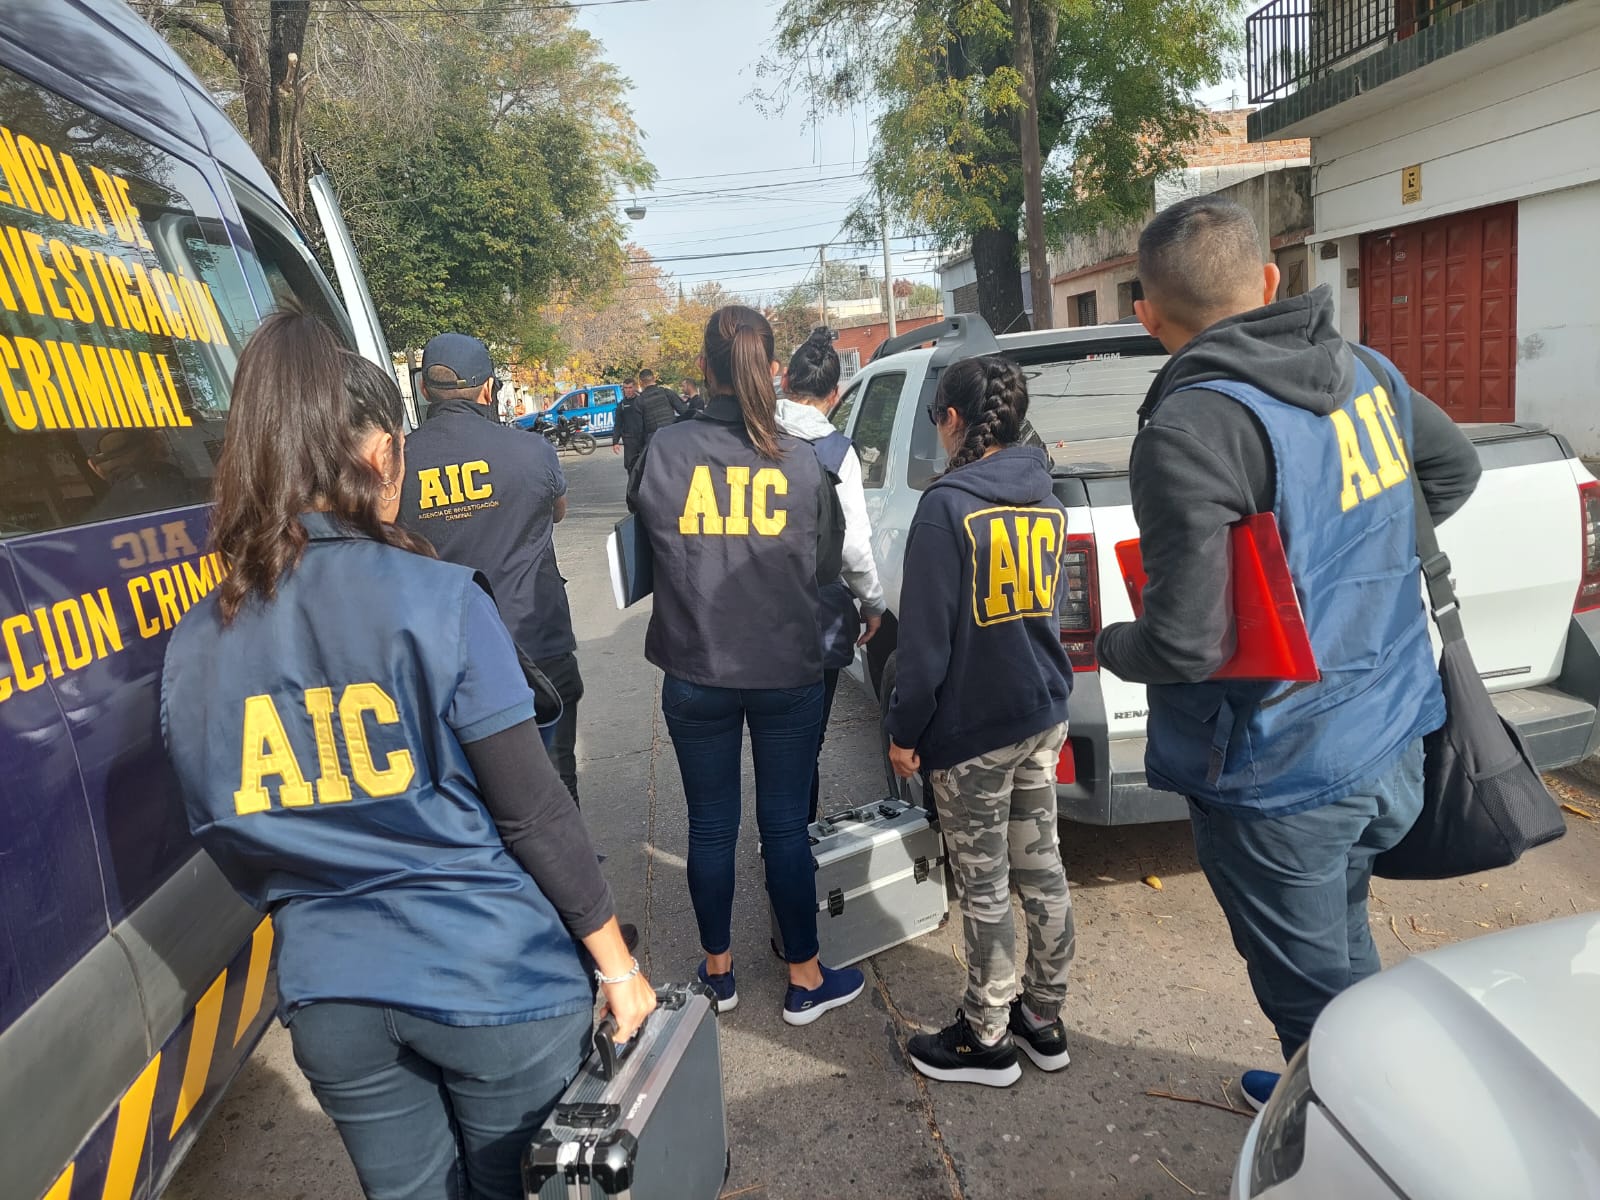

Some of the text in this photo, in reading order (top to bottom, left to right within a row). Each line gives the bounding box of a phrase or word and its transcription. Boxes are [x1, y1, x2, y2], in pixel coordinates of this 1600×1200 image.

[90, 165, 154, 252] DE
[0, 334, 193, 430] CRIMINAL
[576, 411, 615, 429] LICIA
[418, 459, 493, 509] AIC
[418, 510, 444, 520] AGENCIA
[679, 465, 788, 536] AIC
[984, 516, 1056, 618] AIC
[0, 551, 233, 702] CION CRIMI
[233, 682, 416, 816] AIC
[1114, 709, 1151, 720] RENA
